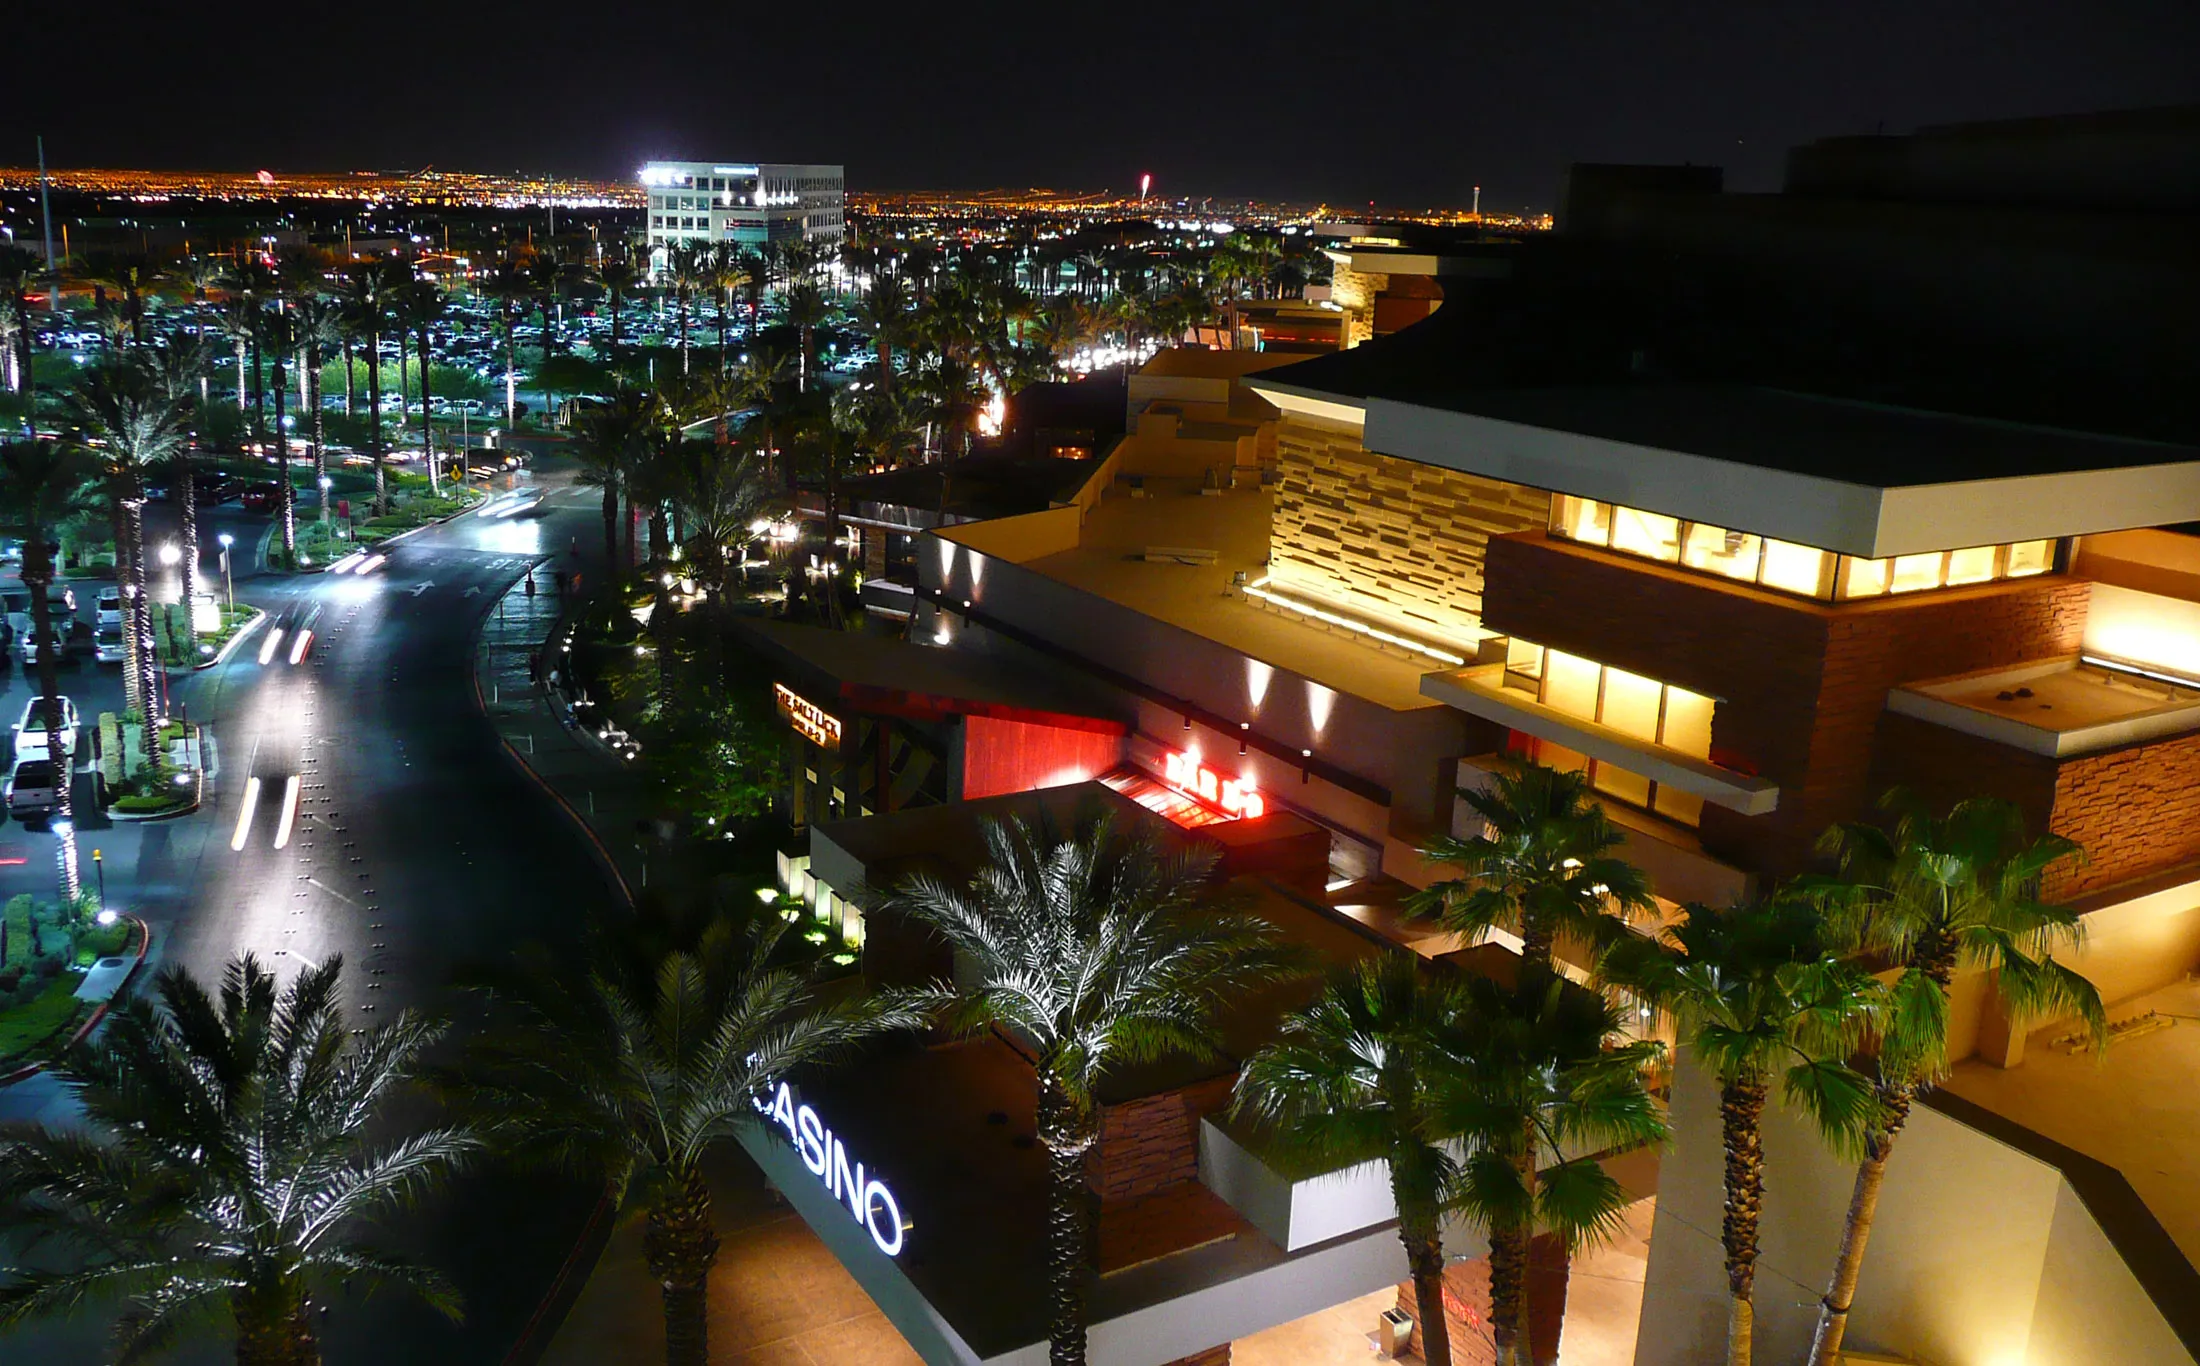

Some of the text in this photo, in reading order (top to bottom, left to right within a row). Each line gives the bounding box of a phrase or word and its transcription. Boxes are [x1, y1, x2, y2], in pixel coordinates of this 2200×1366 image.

[775, 687, 838, 738] THE SALT LICK
